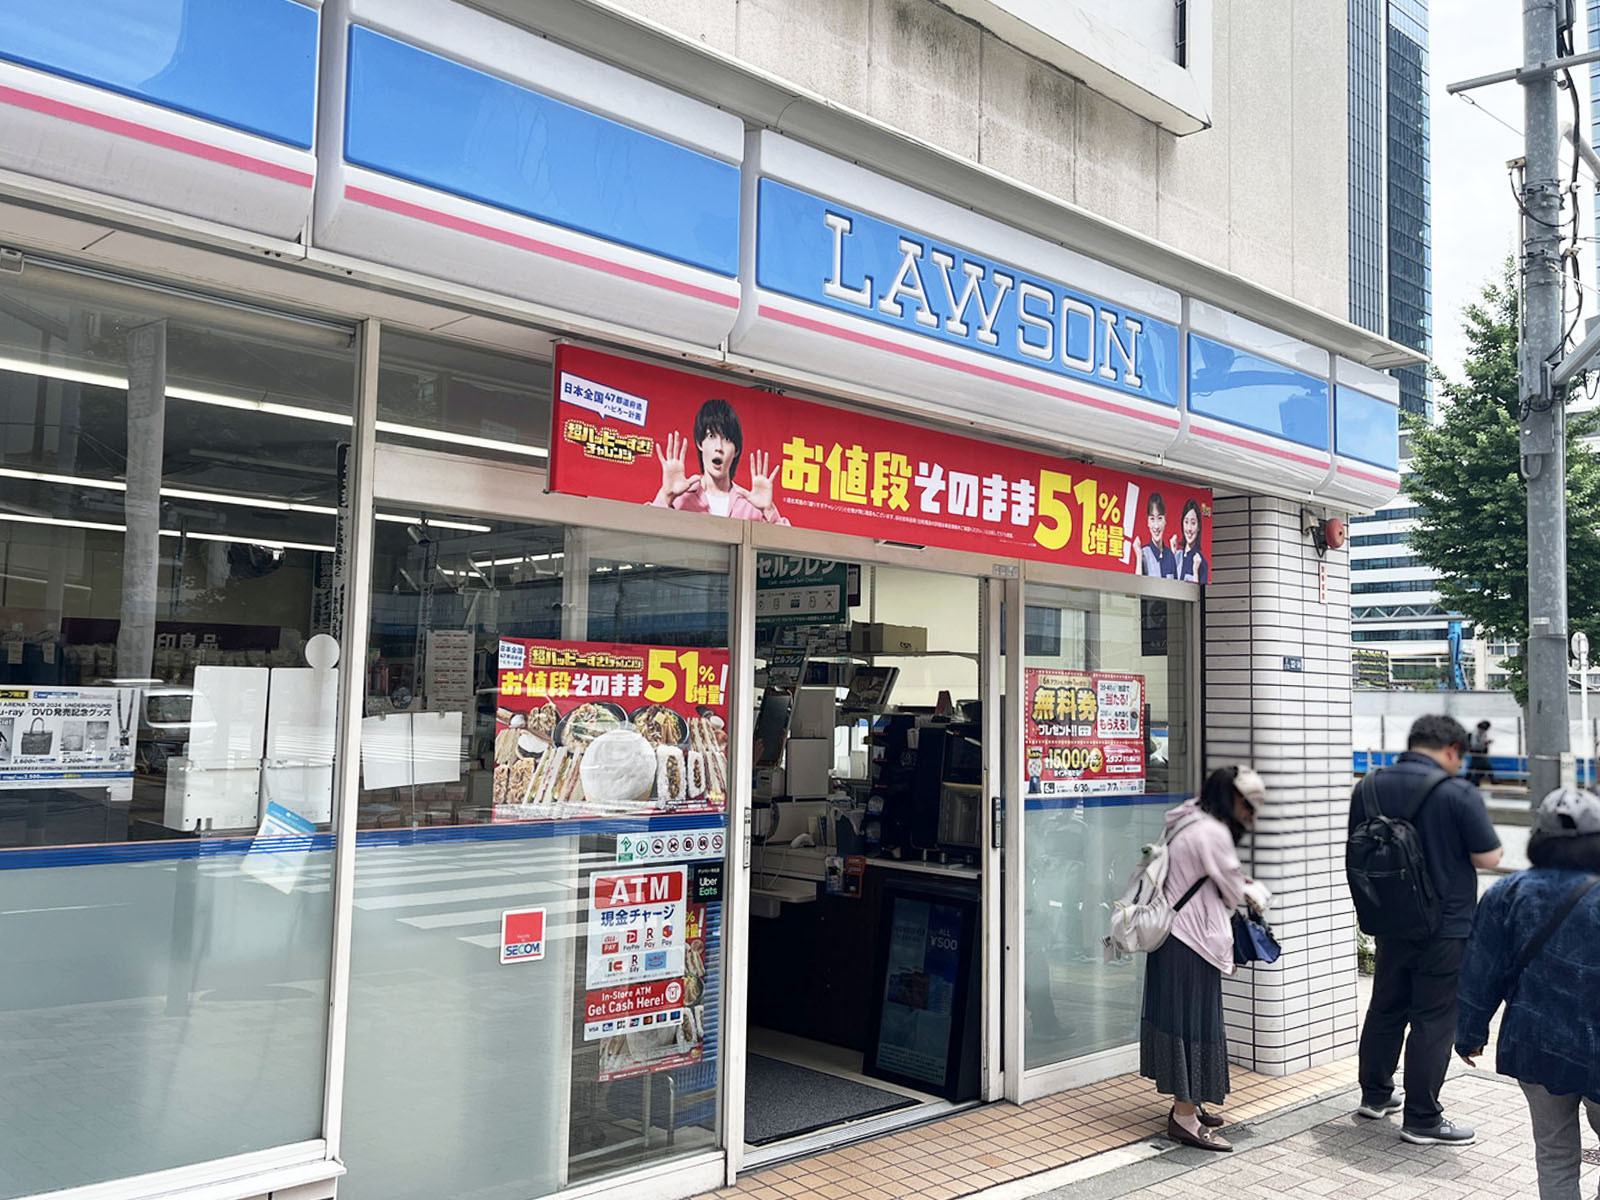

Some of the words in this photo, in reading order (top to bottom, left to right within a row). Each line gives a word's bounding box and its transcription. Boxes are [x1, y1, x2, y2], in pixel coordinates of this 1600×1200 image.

[824, 211, 1142, 388] LAWSON
[564, 382, 604, 404] 日本全国
[1032, 686, 1098, 721] 無料券
[609, 875, 670, 905] ATM
[698, 887, 718, 896] Eats
[699, 877, 718, 887] Uber
[600, 904, 675, 927] 現金チャージ
[506, 943, 540, 956] SECOM
[930, 935, 958, 951] ¥500
[635, 986, 652, 996] ATM
[588, 1004, 606, 1017] Get
[608, 1001, 634, 1014] Cash
[636, 994, 664, 1010] Here!
